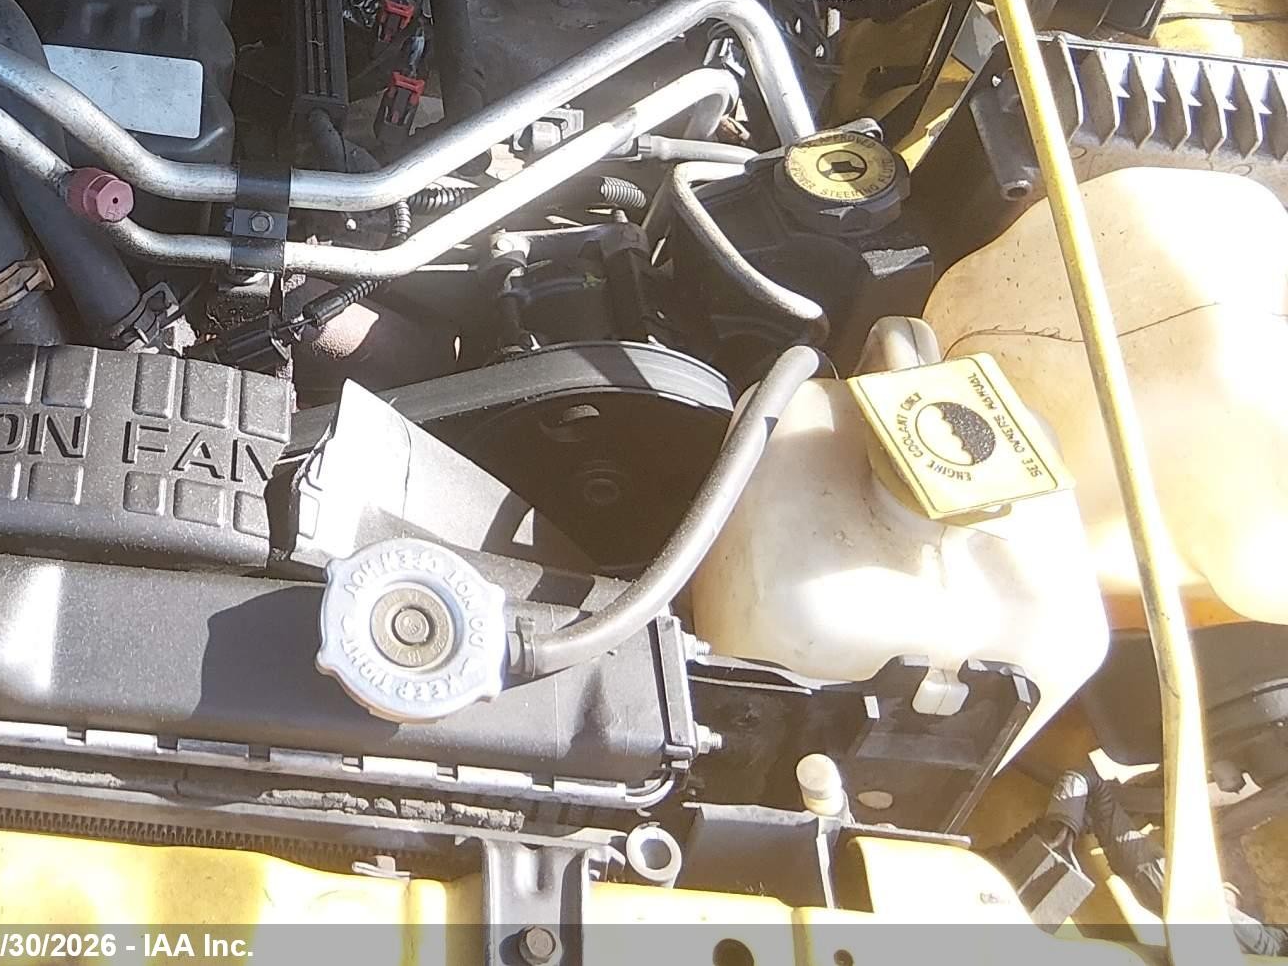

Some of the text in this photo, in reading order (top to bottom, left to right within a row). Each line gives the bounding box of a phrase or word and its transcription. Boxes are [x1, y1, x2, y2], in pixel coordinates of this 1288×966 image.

[967, 372, 998, 411] MANUAL
[896, 413, 925, 459] COOLANT
[926, 459, 972, 482] ENGINE
[1021, 457, 1044, 478] SEE
[396, 672, 464, 702] KEEP
